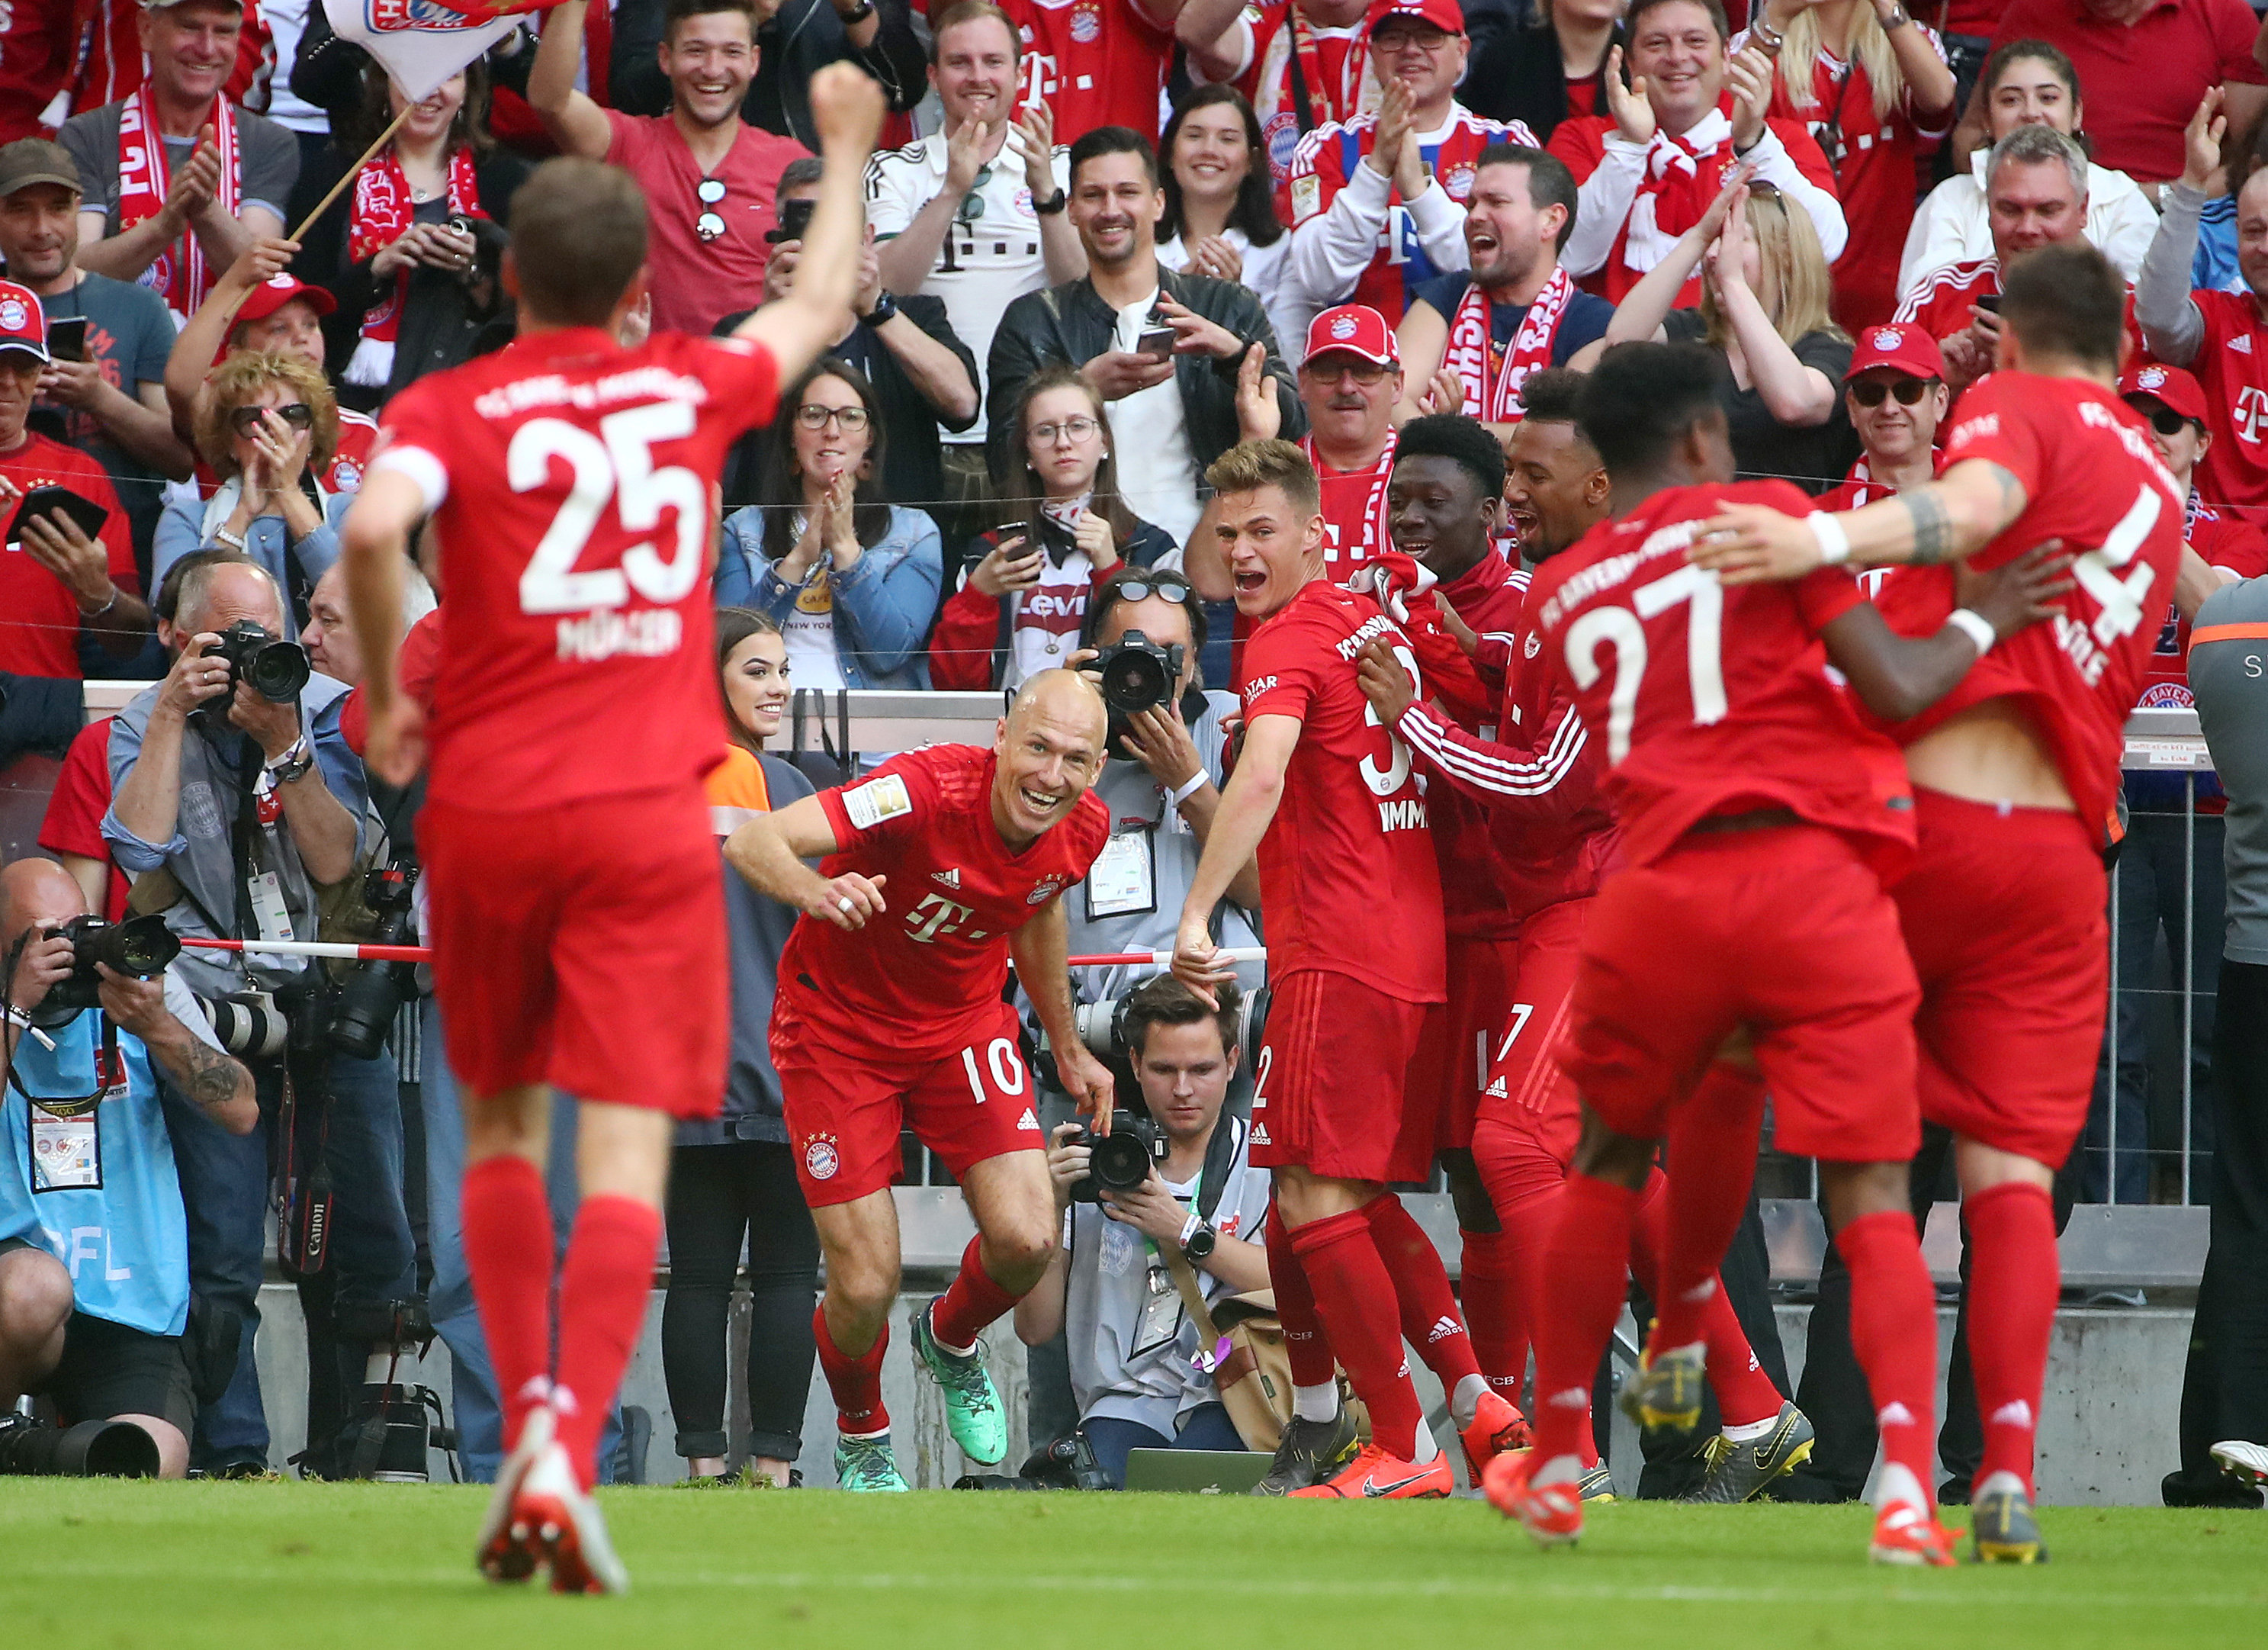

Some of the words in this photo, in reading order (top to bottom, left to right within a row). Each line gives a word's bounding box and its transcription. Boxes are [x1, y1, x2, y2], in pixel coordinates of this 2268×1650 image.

[507, 399, 706, 616] 25
[2071, 482, 2162, 648] 4
[1564, 562, 1729, 768] 27
[961, 1037, 1024, 1105] 10
[308, 1204, 326, 1257] Canon
[1428, 1324, 1464, 1344] adidas
